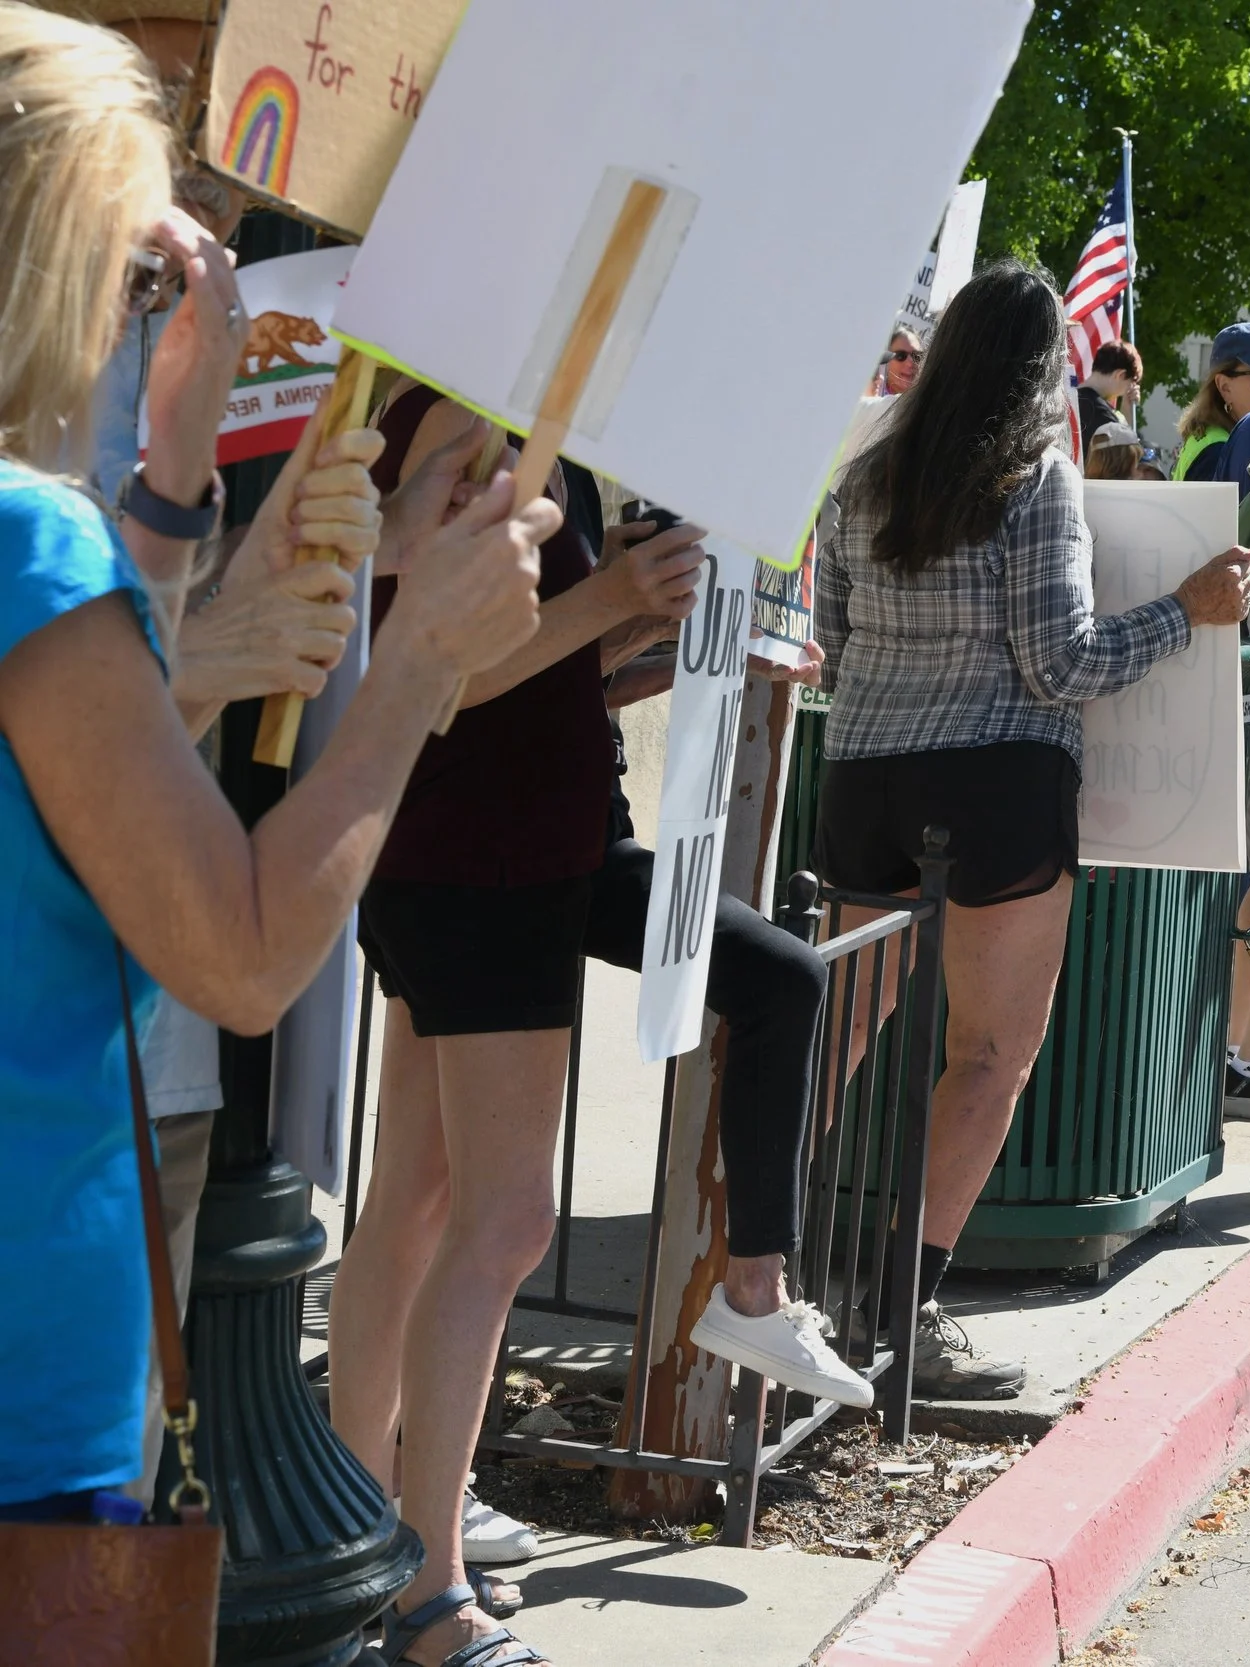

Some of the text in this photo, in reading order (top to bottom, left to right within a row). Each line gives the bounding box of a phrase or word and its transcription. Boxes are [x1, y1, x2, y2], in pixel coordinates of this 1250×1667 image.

[304, 4, 355, 96] for
[757, 598, 810, 644] KINGS DAY
